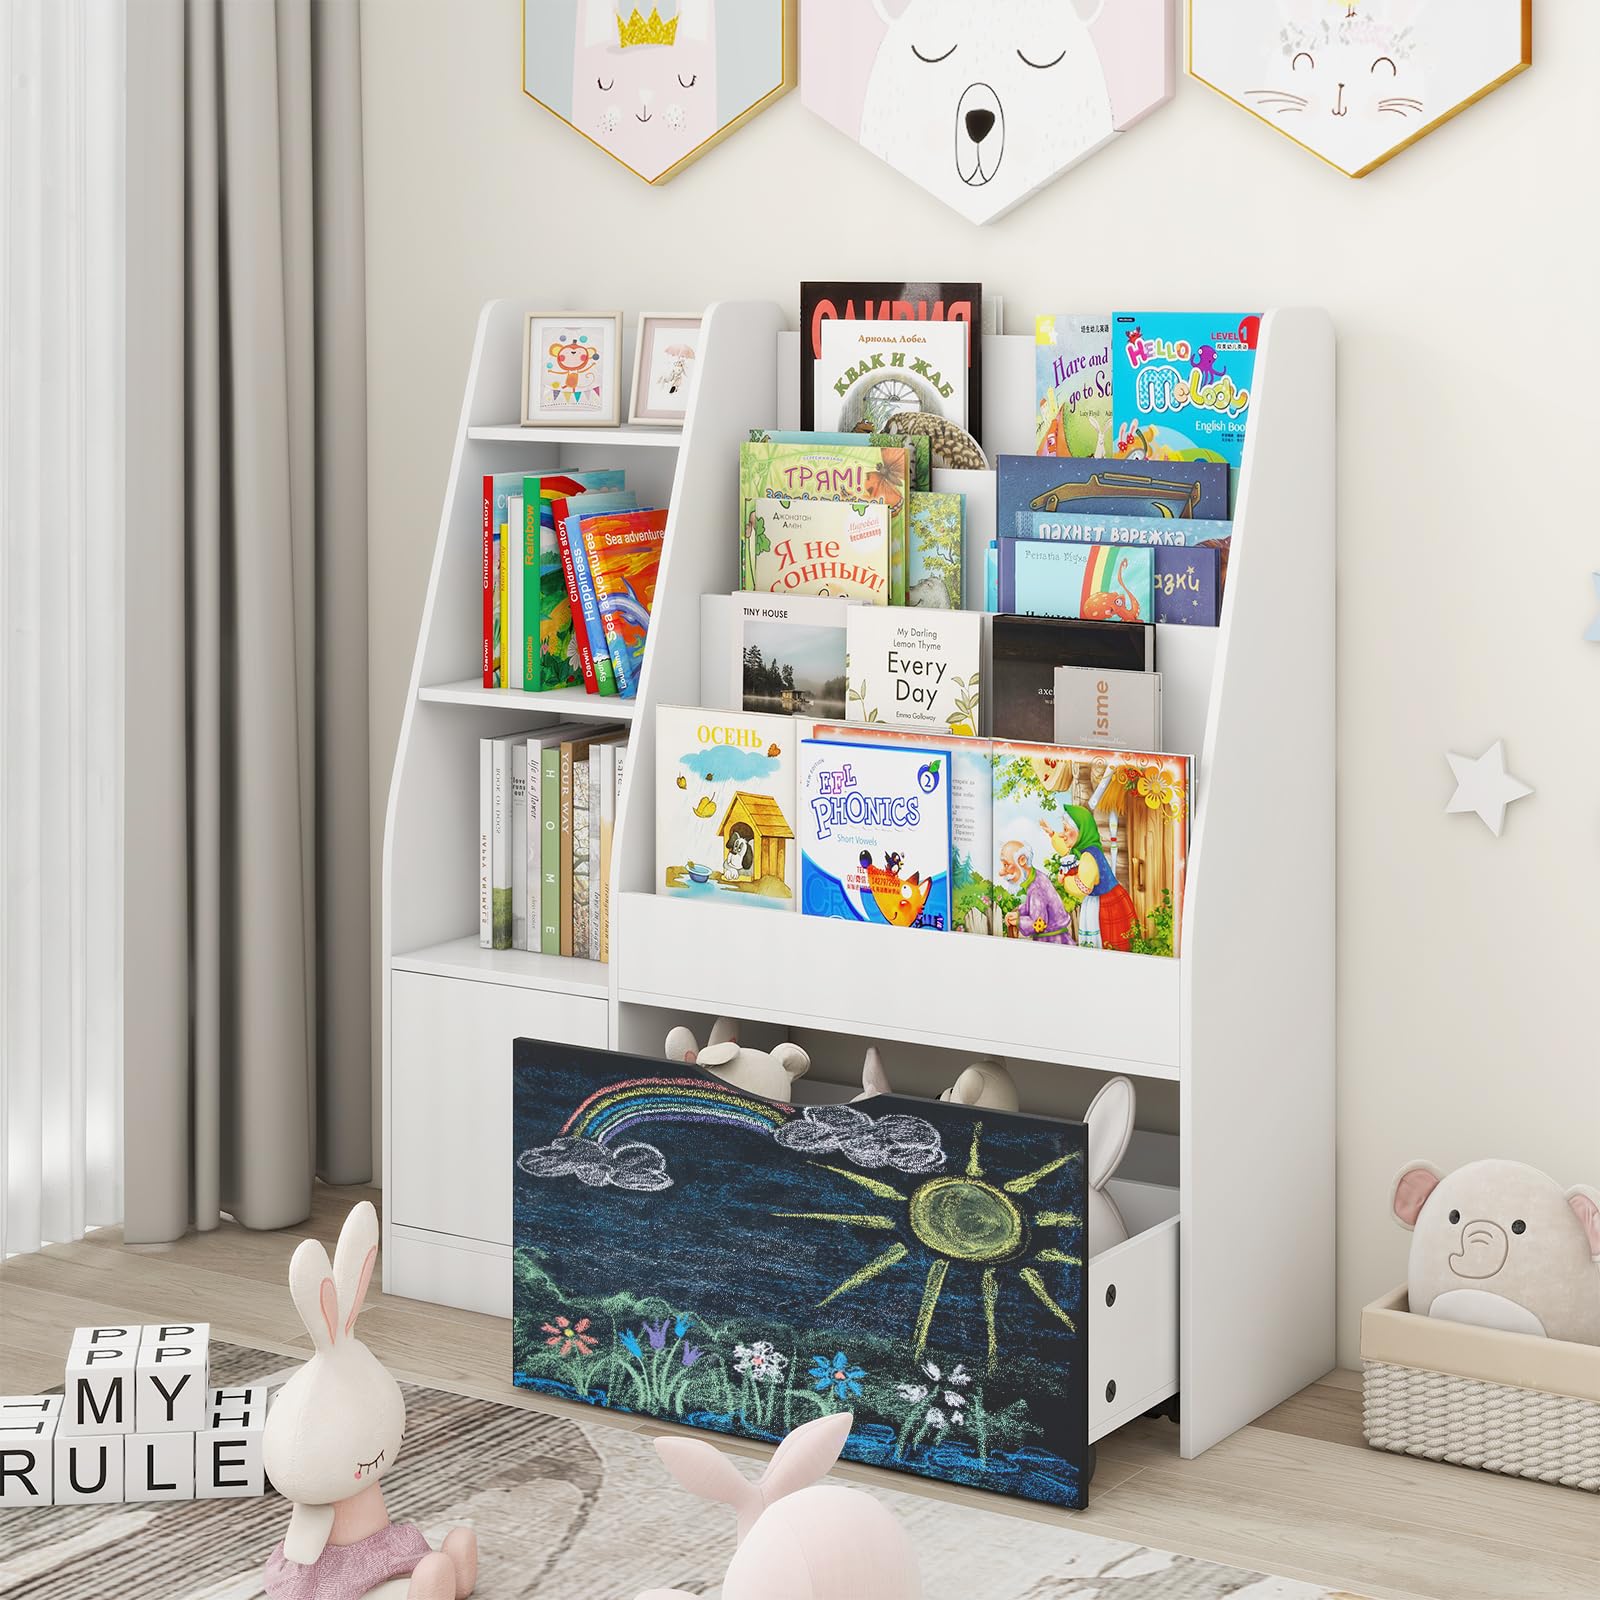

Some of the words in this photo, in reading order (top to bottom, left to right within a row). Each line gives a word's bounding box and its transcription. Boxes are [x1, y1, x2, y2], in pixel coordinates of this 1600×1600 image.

[858, 335, 897, 344] Арнольд
[899, 334, 927, 343] Лобел
[1210, 331, 1239, 340] LEVEL
[1052, 355, 1087, 389] Hare
[1088, 346, 1109, 367] and
[1126, 340, 1190, 367] HELLO
[833, 352, 886, 397] КВАК
[891, 352, 906, 367] И
[909, 356, 954, 399] ЖАБ
[1069, 390, 1081, 414] go
[1083, 383, 1093, 400] to
[1195, 420, 1226, 434] English
[784, 466, 862, 493] ТРЯМ!
[773, 512, 812, 521] Джонатан
[782, 520, 802, 529] Ален
[525, 504, 535, 566] Rainbow
[558, 519, 570, 547] story
[605, 533, 623, 546] Sea
[774, 539, 797, 572] Я
[805, 540, 840, 560] не
[563, 548, 579, 603] Children's
[573, 548, 596, 622] Happiness
[585, 533, 610, 609] adventures
[743, 607, 760, 616] TINY
[762, 609, 788, 618] HOUSE
[603, 613, 617, 642] Sea
[897, 627, 909, 638] My
[910, 628, 938, 641] Darling
[525, 636, 534, 681] Columbia
[893, 639, 916, 649] Lemon
[917, 640, 942, 651] Thyme
[582, 646, 593, 678] Darwin
[594, 652, 606, 682] Sydney
[612, 650, 627, 689] Louisiana
[887, 651, 947, 684] Every
[896, 679, 938, 710] Day
[1038, 687, 1055, 696] axe
[896, 711, 912, 720] Emma
[912, 712, 936, 722] Galloway
[1093, 680, 1109, 736] isme
[697, 724, 763, 748] ОСЕНЬ
[512, 776, 525, 784] love
[528, 759, 539, 774] life
[561, 752, 569, 797] YOUR
[819, 764, 857, 795] EFL
[924, 774, 932, 788] 2
[528, 792, 539, 819] flower
[561, 801, 569, 835] WAY
[811, 791, 921, 840] PHONICS
[545, 769, 556, 934] HOME
[836, 833, 854, 844] Short
[855, 835, 878, 847] Vowels
[91, 1328, 127, 1344] P
[159, 1326, 195, 1341] P
[86, 1349, 123, 1365] P
[155, 1347, 192, 1363] P
[77, 1374, 192, 1425] MY
[0, 1440, 248, 1496] RULE
